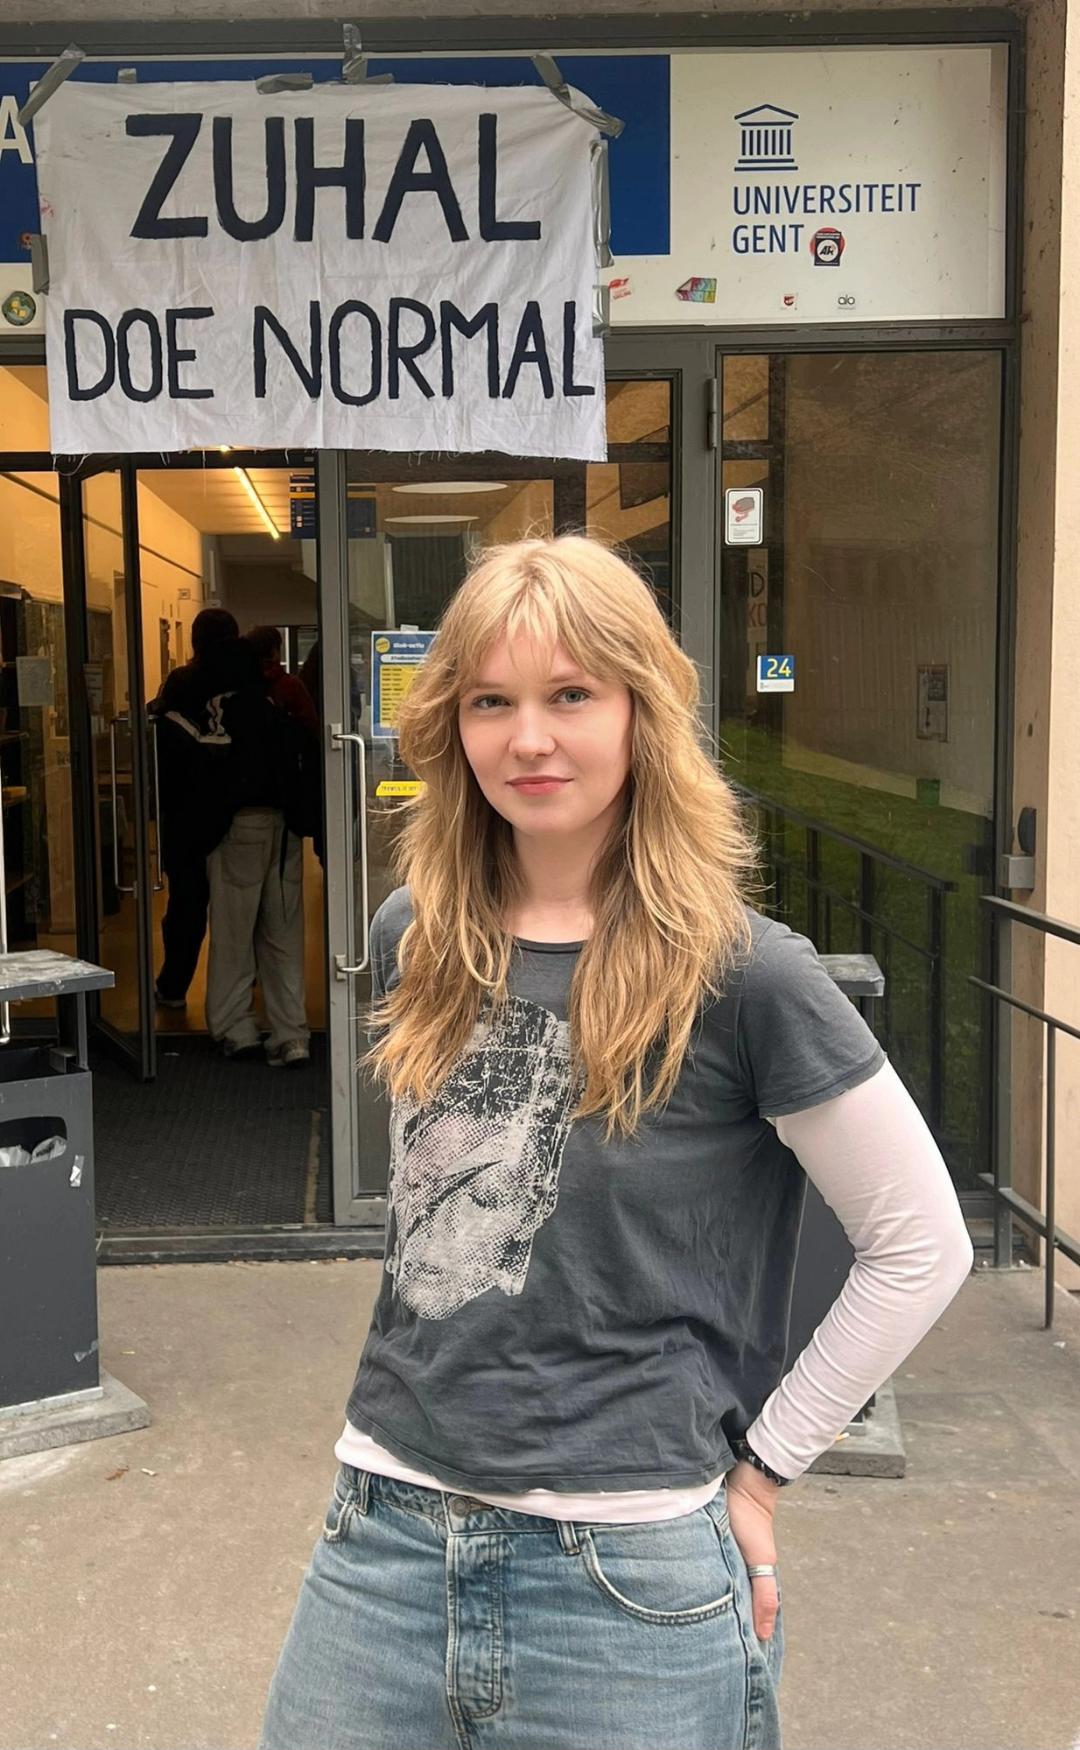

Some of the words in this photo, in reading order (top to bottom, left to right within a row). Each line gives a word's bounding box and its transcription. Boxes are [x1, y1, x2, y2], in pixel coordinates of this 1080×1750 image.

[125, 113, 541, 243] ZUHAL
[733, 183, 922, 215] UNIVERSITEIT
[733, 224, 804, 254] GENT
[64, 307, 214, 402] DOE
[254, 298, 596, 406] NORMAL
[766, 657, 792, 678] 24
